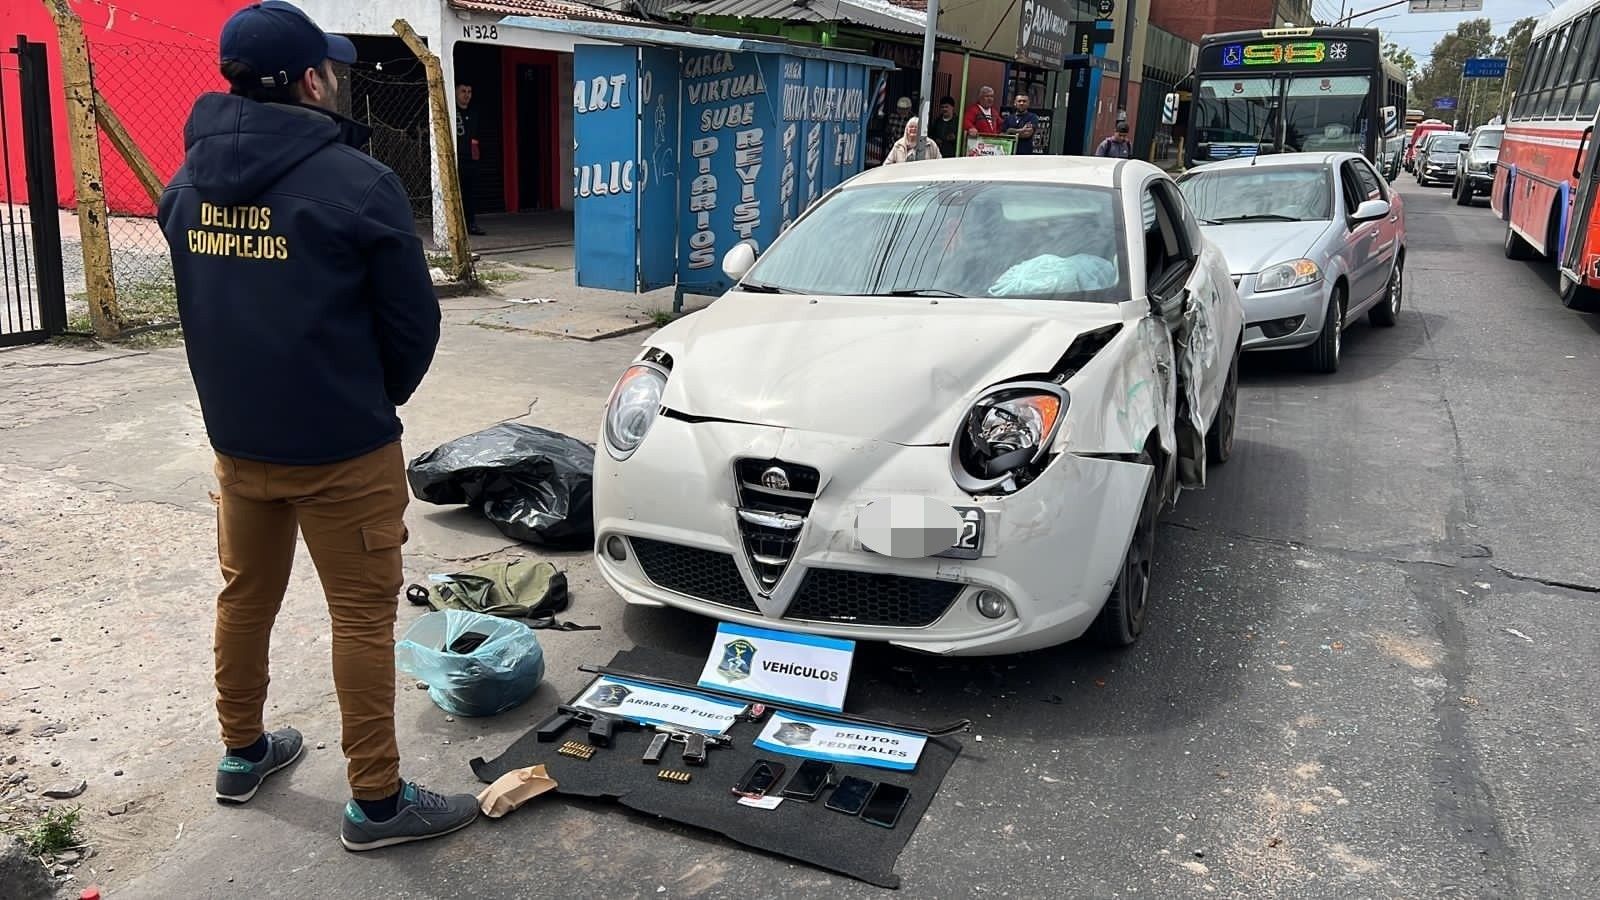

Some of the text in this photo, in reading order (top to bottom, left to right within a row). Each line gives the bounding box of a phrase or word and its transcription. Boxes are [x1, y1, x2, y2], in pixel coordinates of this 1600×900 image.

[685, 52, 735, 78] CARGA
[688, 74, 768, 105] VIRTUAL
[700, 101, 755, 132] SUBE
[688, 136, 720, 269] DIARIOS
[201, 202, 271, 231] DELITOS
[187, 229, 289, 260] COMPLEJOS
[762, 660, 839, 682] VEHÍCULOS
[626, 697, 736, 721] ARMAS DE FUEGO
[817, 740, 908, 758] FEDERALES
[835, 731, 900, 746] DELITOS
